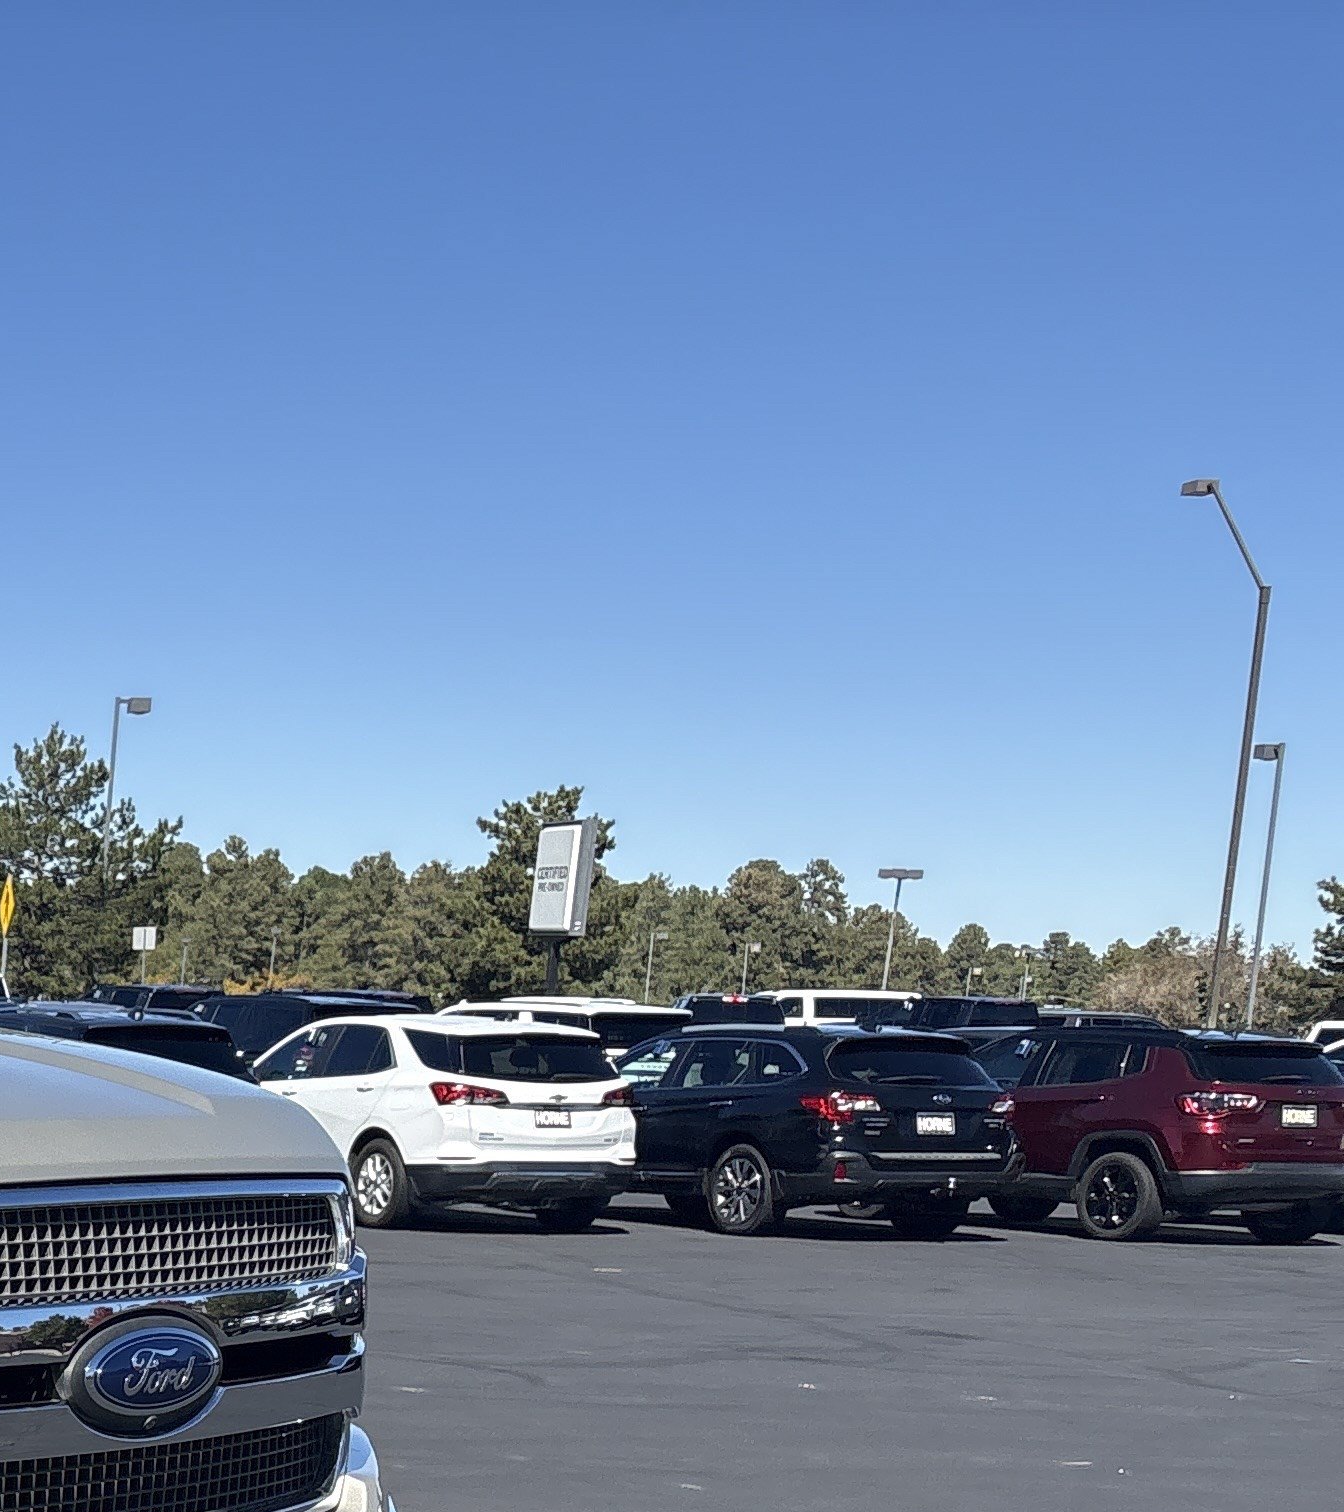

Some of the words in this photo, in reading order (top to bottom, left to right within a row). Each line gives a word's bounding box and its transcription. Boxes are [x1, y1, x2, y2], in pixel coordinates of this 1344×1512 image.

[536, 1110, 570, 1126] HORNE
[917, 1116, 953, 1132] HORNE
[124, 1347, 196, 1396] Ford
